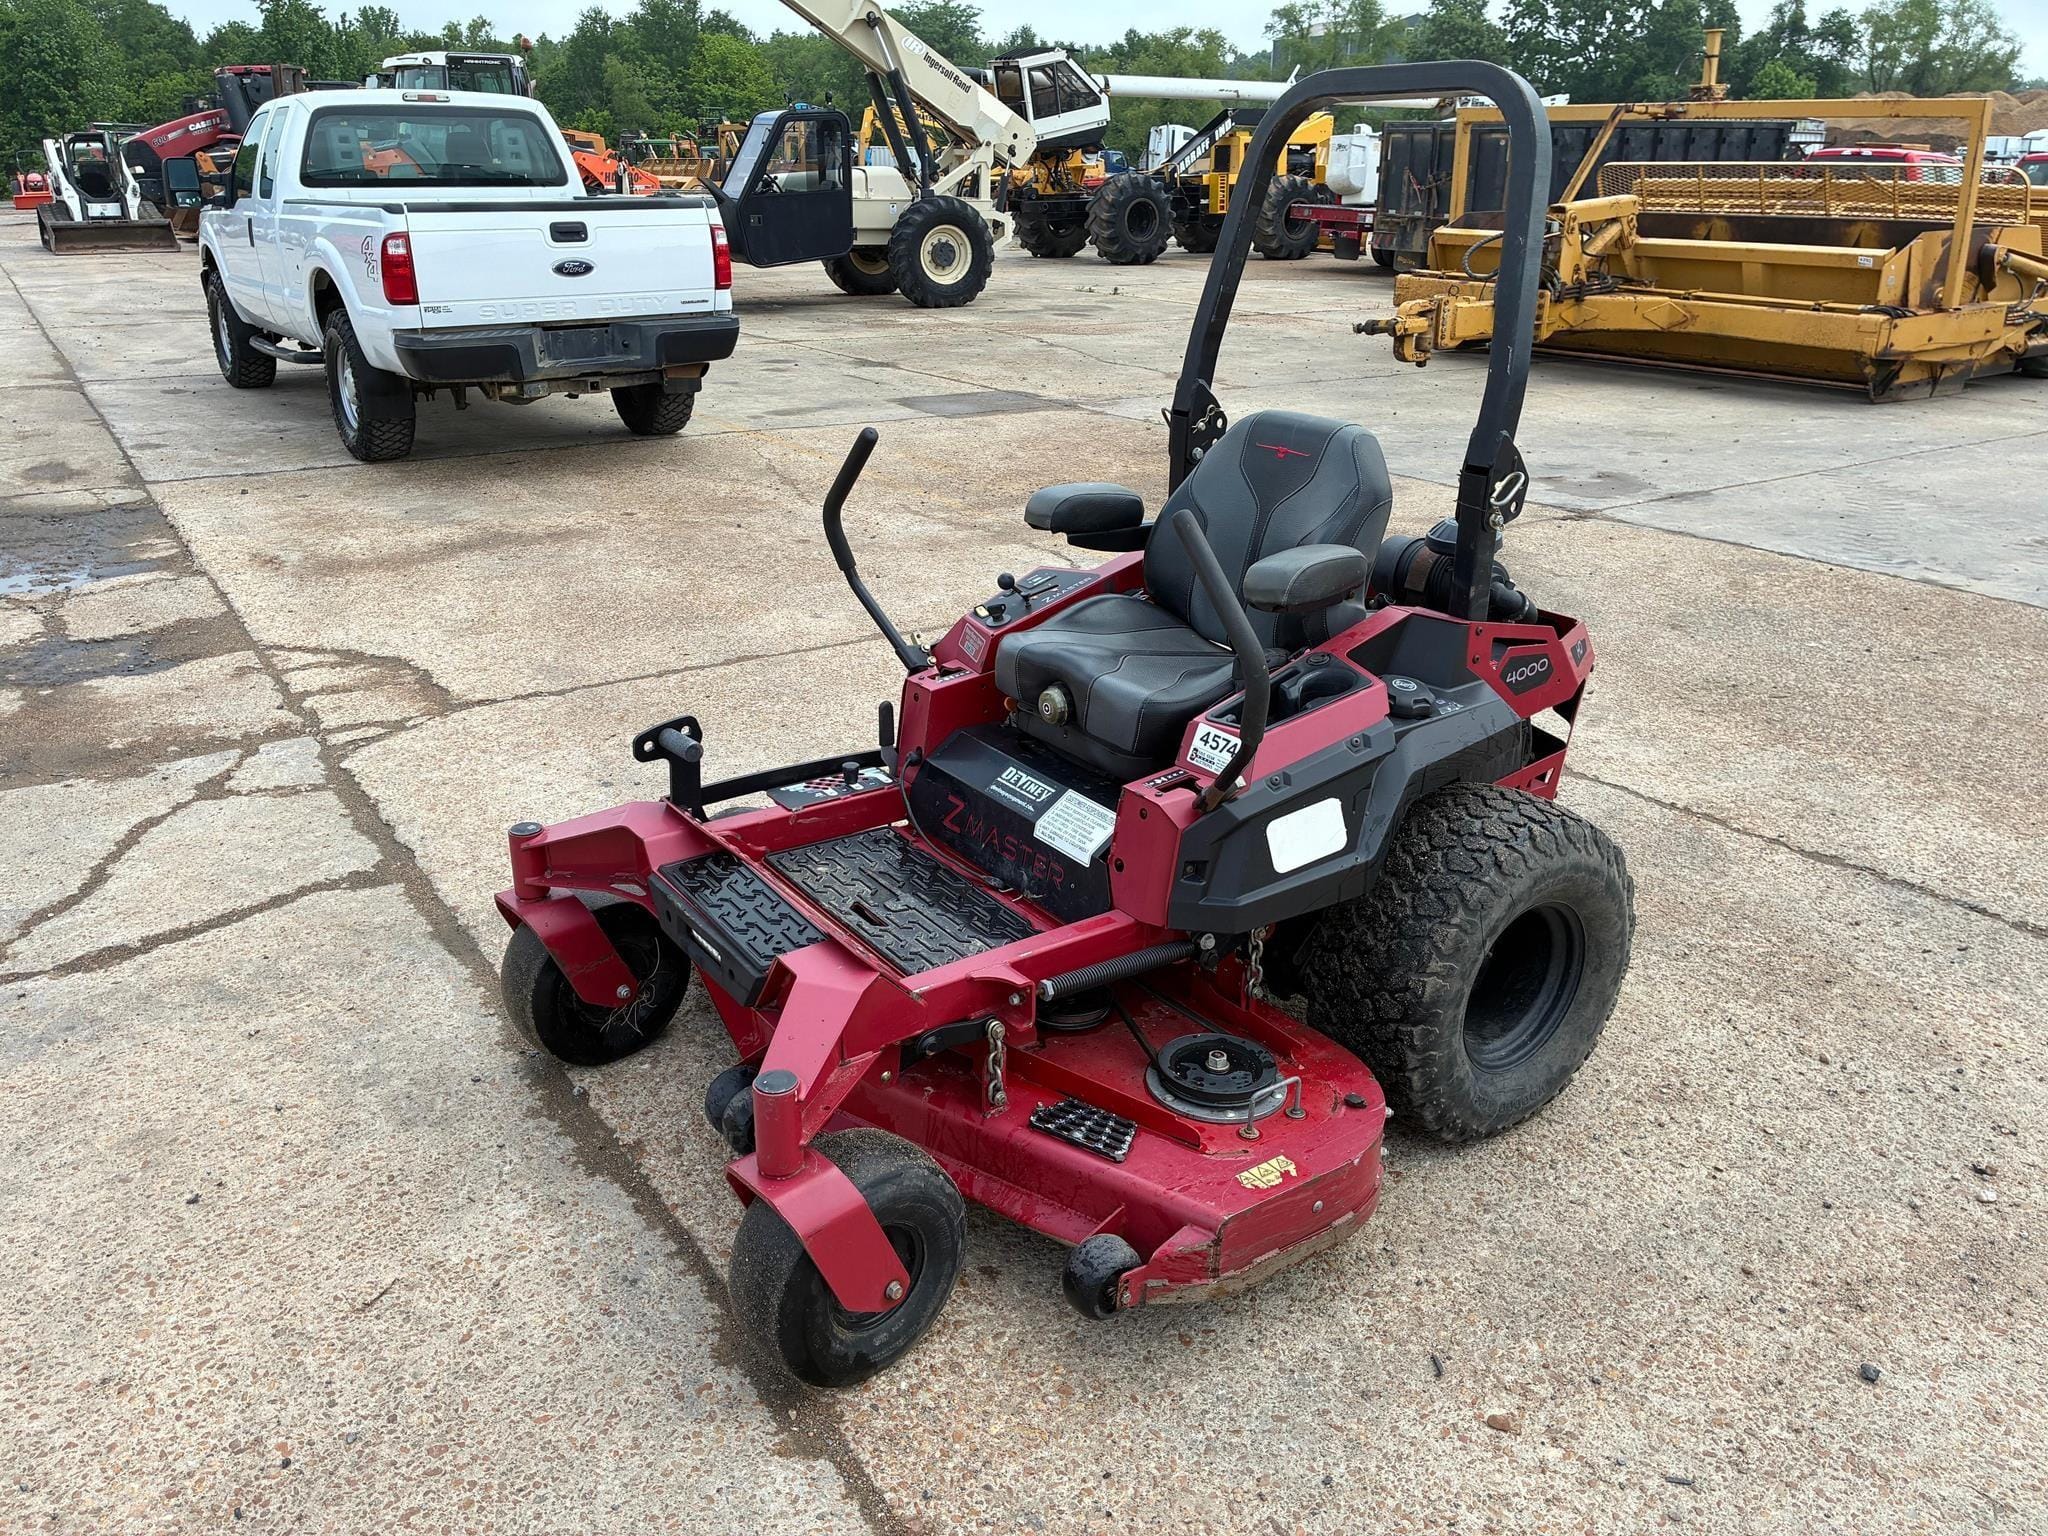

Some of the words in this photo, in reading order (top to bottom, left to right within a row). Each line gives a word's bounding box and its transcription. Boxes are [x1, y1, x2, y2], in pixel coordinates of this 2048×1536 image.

[188, 119, 212, 131] CASE
[479, 301, 577, 321] SUPER
[593, 296, 669, 315] DUTY
[1506, 658, 1549, 684] 4000
[1199, 731, 1239, 758] 4574
[943, 794, 967, 834] Z
[964, 814, 1065, 889] MASTER
